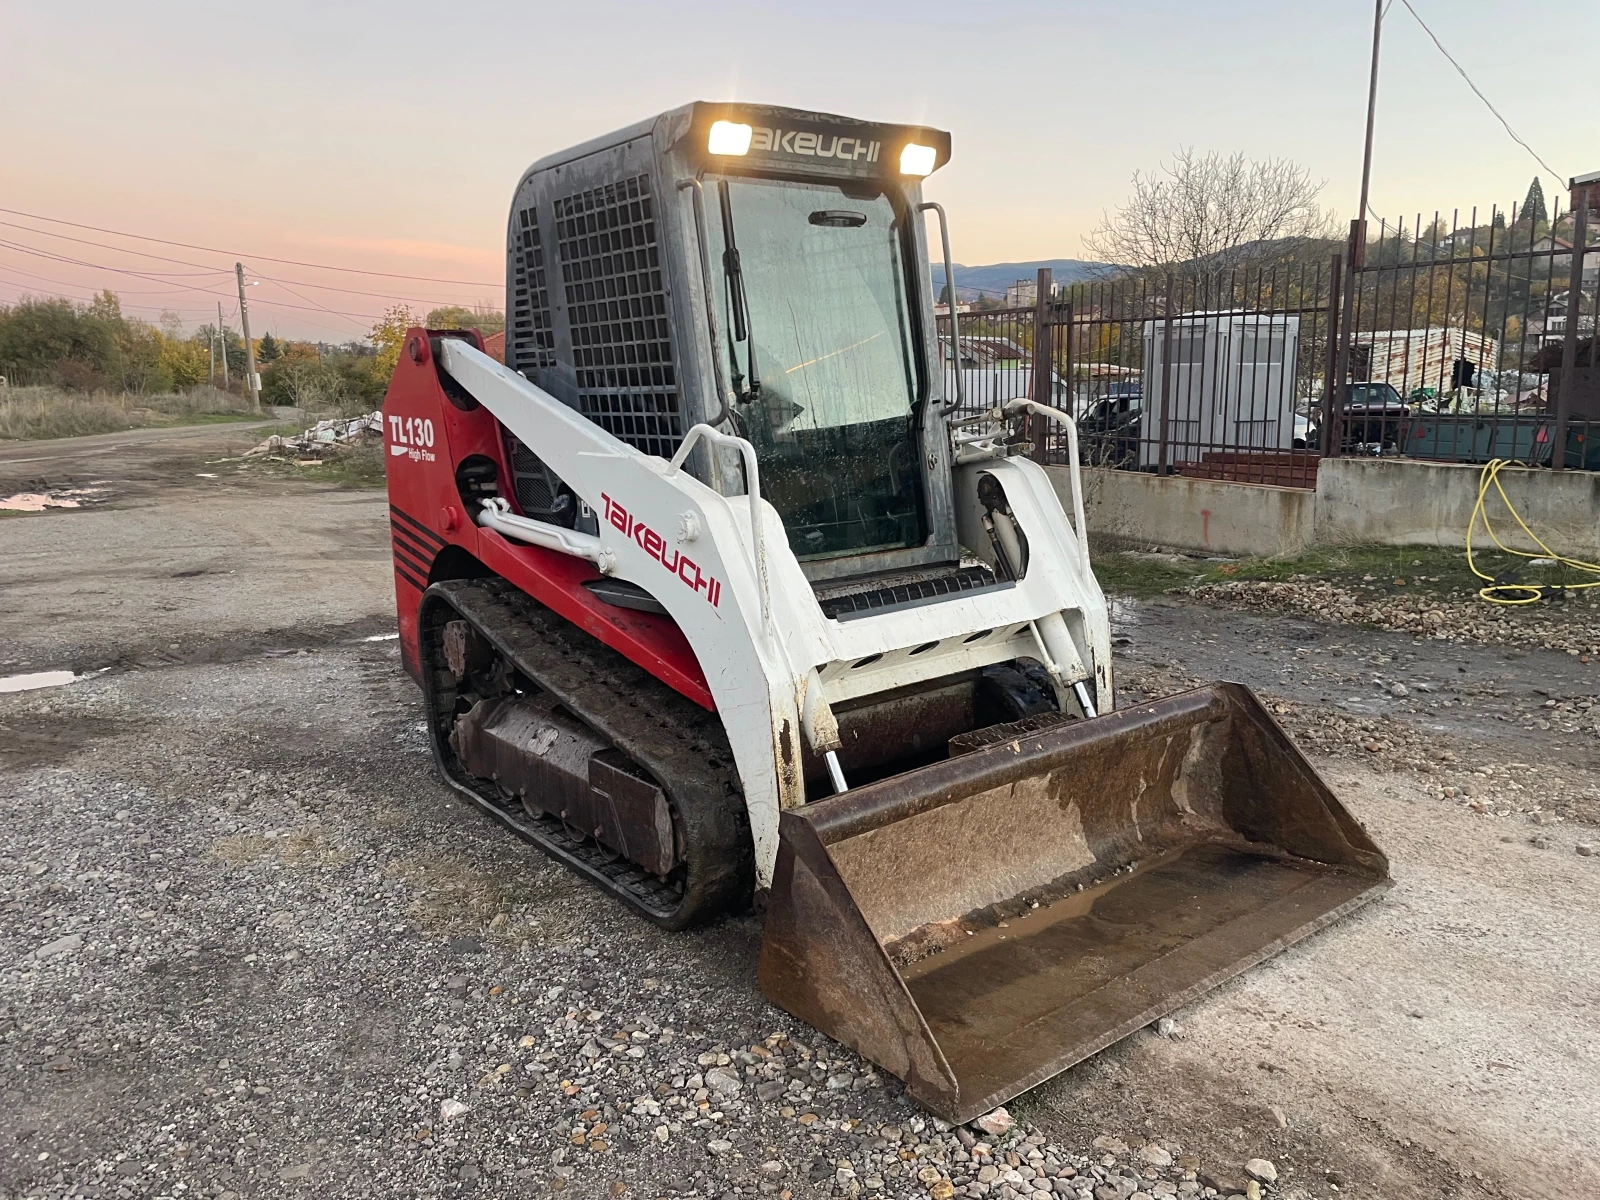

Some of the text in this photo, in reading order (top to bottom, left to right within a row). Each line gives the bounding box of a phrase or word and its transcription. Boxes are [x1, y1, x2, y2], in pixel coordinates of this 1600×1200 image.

[388, 415, 434, 447] TL130
[409, 447, 435, 462] High Flow
